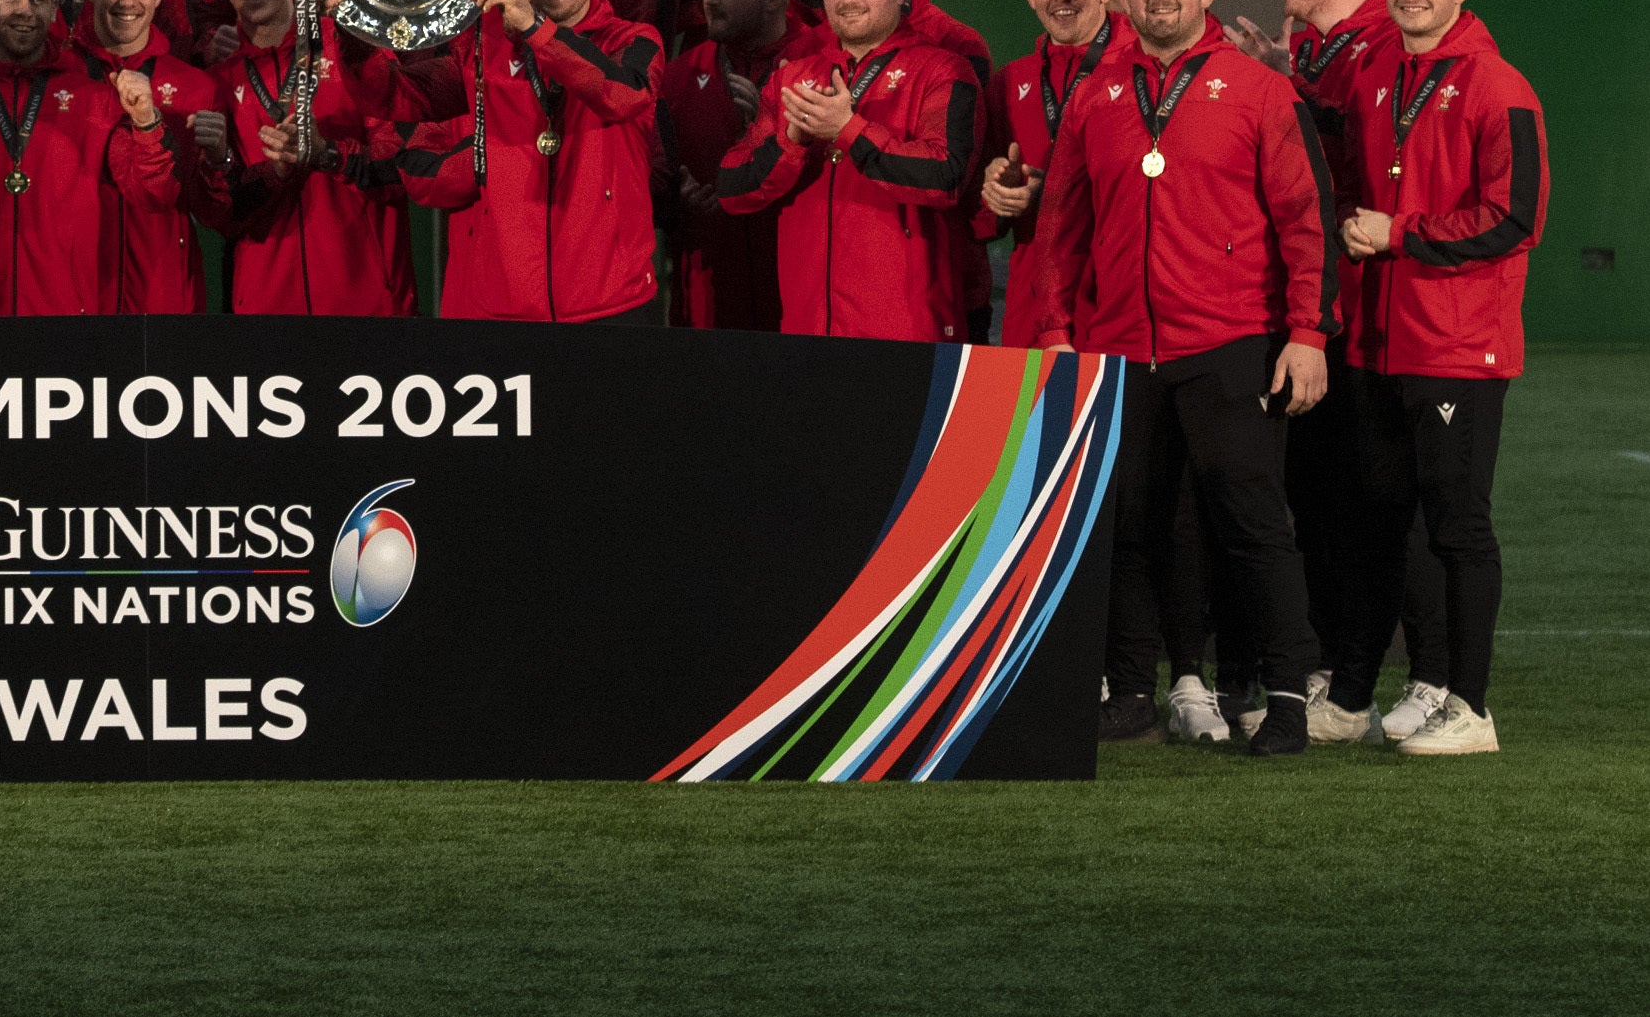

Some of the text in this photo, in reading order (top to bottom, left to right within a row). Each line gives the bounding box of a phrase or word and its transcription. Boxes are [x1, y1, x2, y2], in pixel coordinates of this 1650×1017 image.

[852, 64, 880, 99] GUINNESS
[1164, 72, 1191, 110] GUINNESS
[1407, 79, 1436, 118] GUINNESS
[297, 71, 309, 152] GUINNESS
[338, 373, 533, 438] 2021
[74, 584, 316, 626] NATIONS
